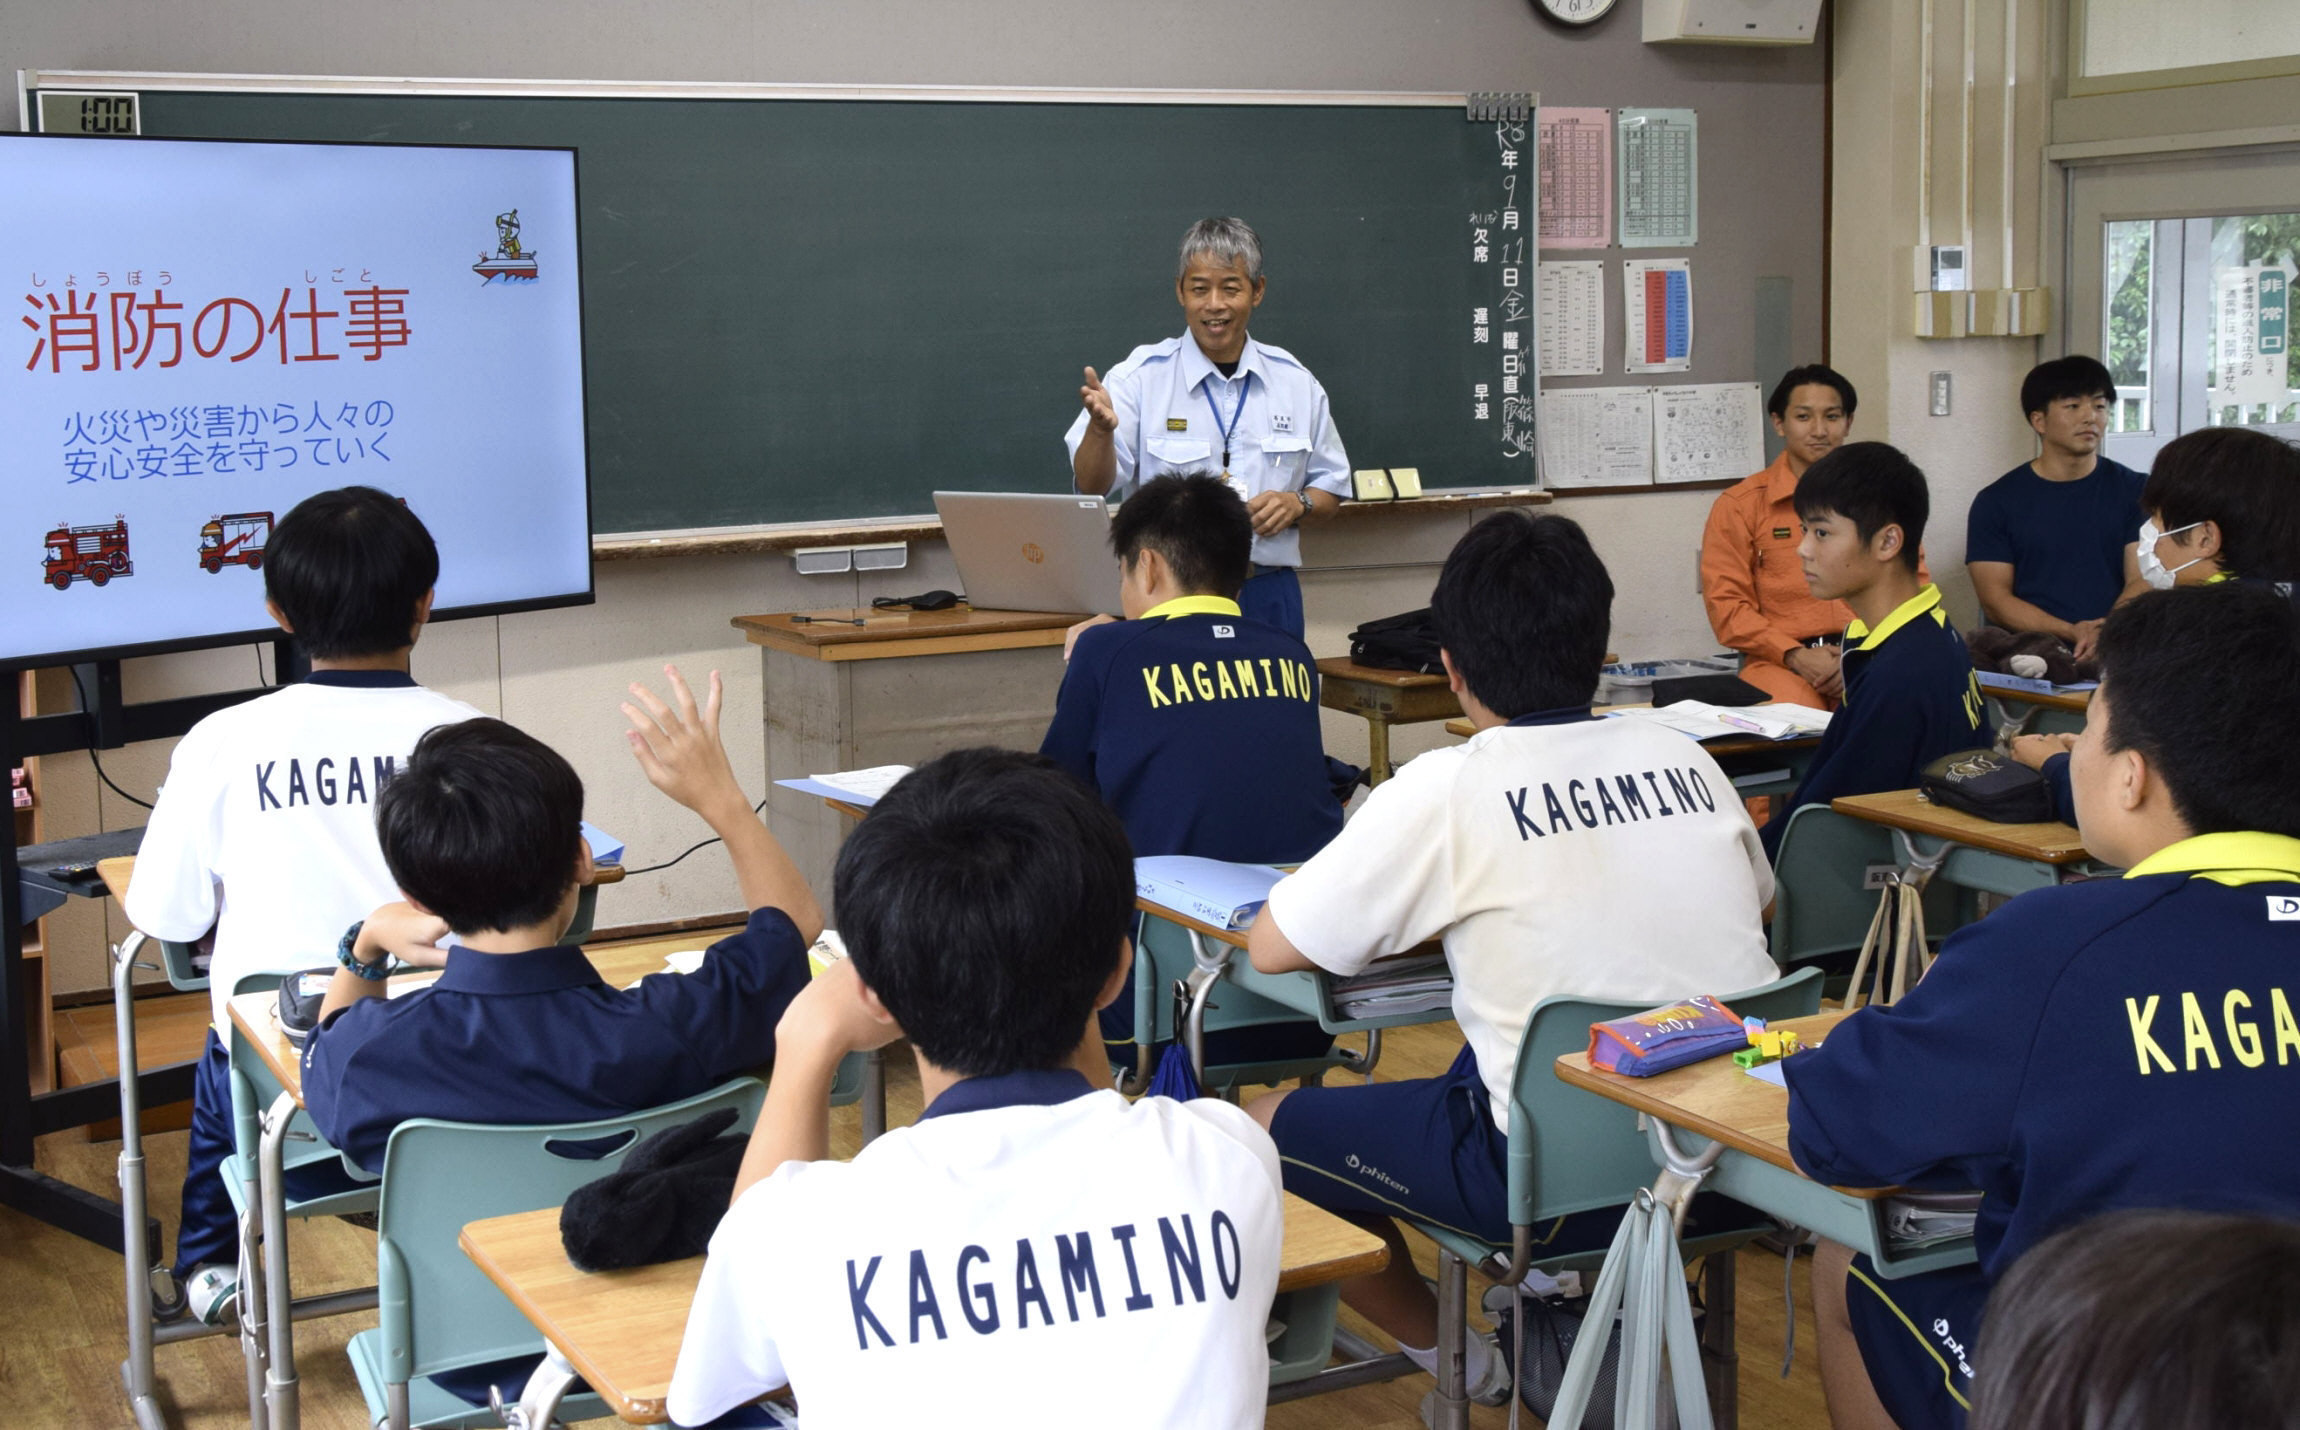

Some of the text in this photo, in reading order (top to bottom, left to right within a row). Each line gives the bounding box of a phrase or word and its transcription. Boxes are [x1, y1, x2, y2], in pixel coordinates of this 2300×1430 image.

[81, 97, 133, 133] 1:00
[1473, 228, 1489, 263] 欠席
[31, 267, 372, 288] しょうぼう しごと
[21, 285, 413, 373] 消防の仕事
[1473, 307, 1489, 344] 遅刻
[2260, 278, 2284, 349] 非常口
[64, 400, 394, 446] 火災や災害から人々の
[1473, 383, 1490, 420] 早退
[65, 432, 391, 484] 安心安全を守っていく
[1142, 658, 1311, 708] KAGAMINO
[256, 756, 412, 812] KAGAM
[1504, 766, 1717, 842] KAGAMINO
[2125, 987, 2300, 1075] KAGA
[1360, 1164, 1409, 1195] phiten
[845, 1209, 1242, 1351] KAGAMINO
